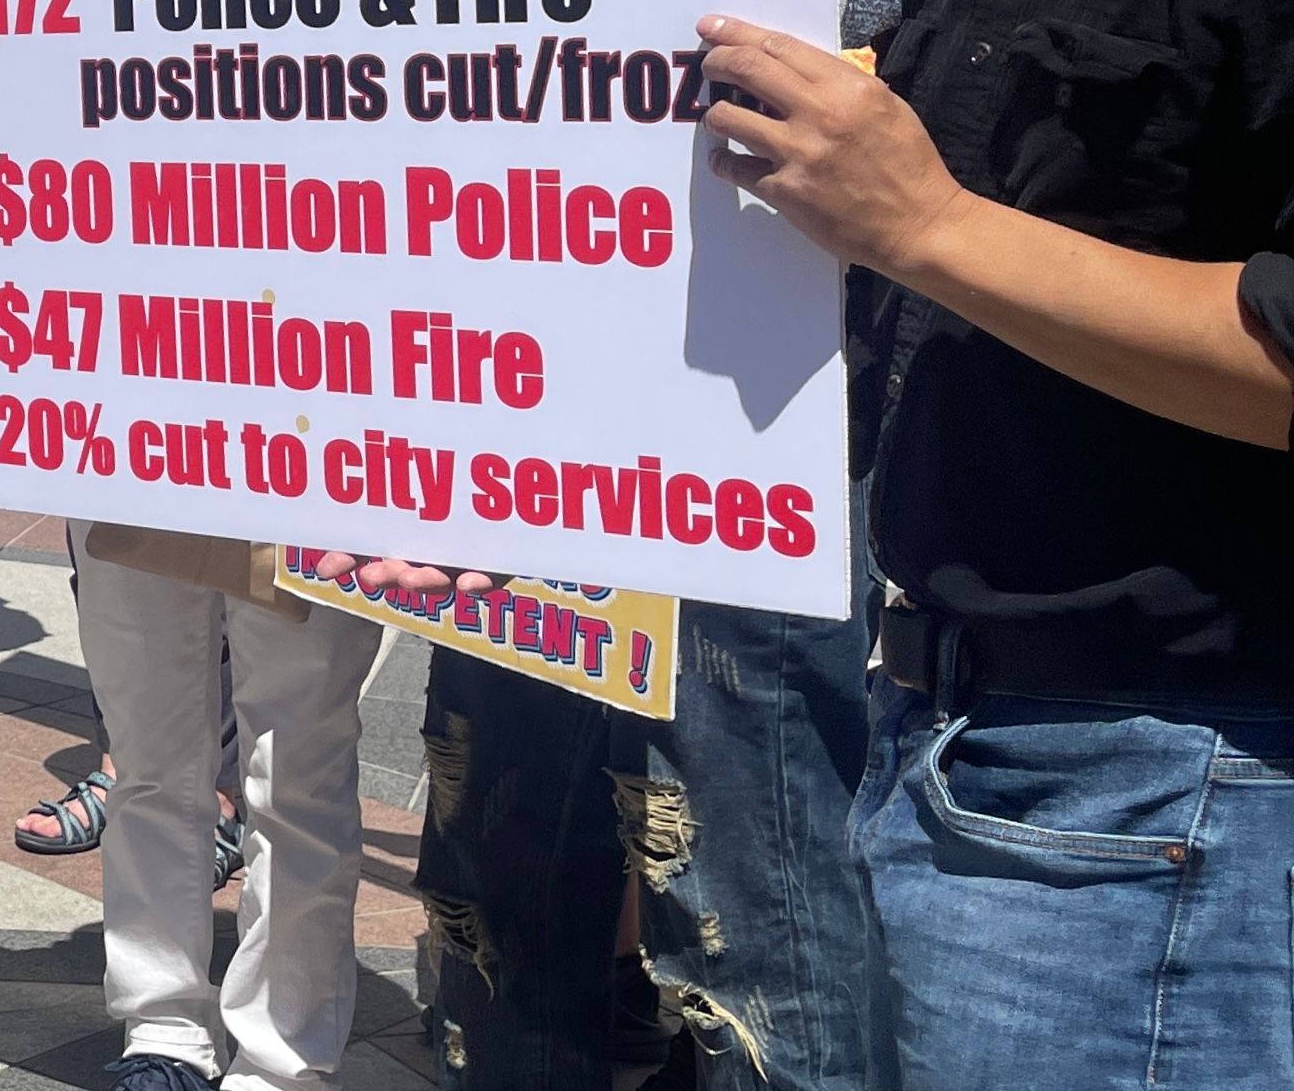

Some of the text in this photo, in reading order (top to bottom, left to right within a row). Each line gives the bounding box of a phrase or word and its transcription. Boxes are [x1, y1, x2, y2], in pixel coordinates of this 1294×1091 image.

[81, 37, 711, 129] positions cut/froz
[130, 162, 388, 255] Million
[407, 166, 674, 268] Police
[118, 294, 373, 396] Million
[391, 309, 545, 410] Fire
[128, 416, 232, 490] cut
[243, 421, 308, 497] to
[323, 430, 455, 522] city
[472, 456, 817, 559] services
[284, 545, 615, 677] IPETENT
